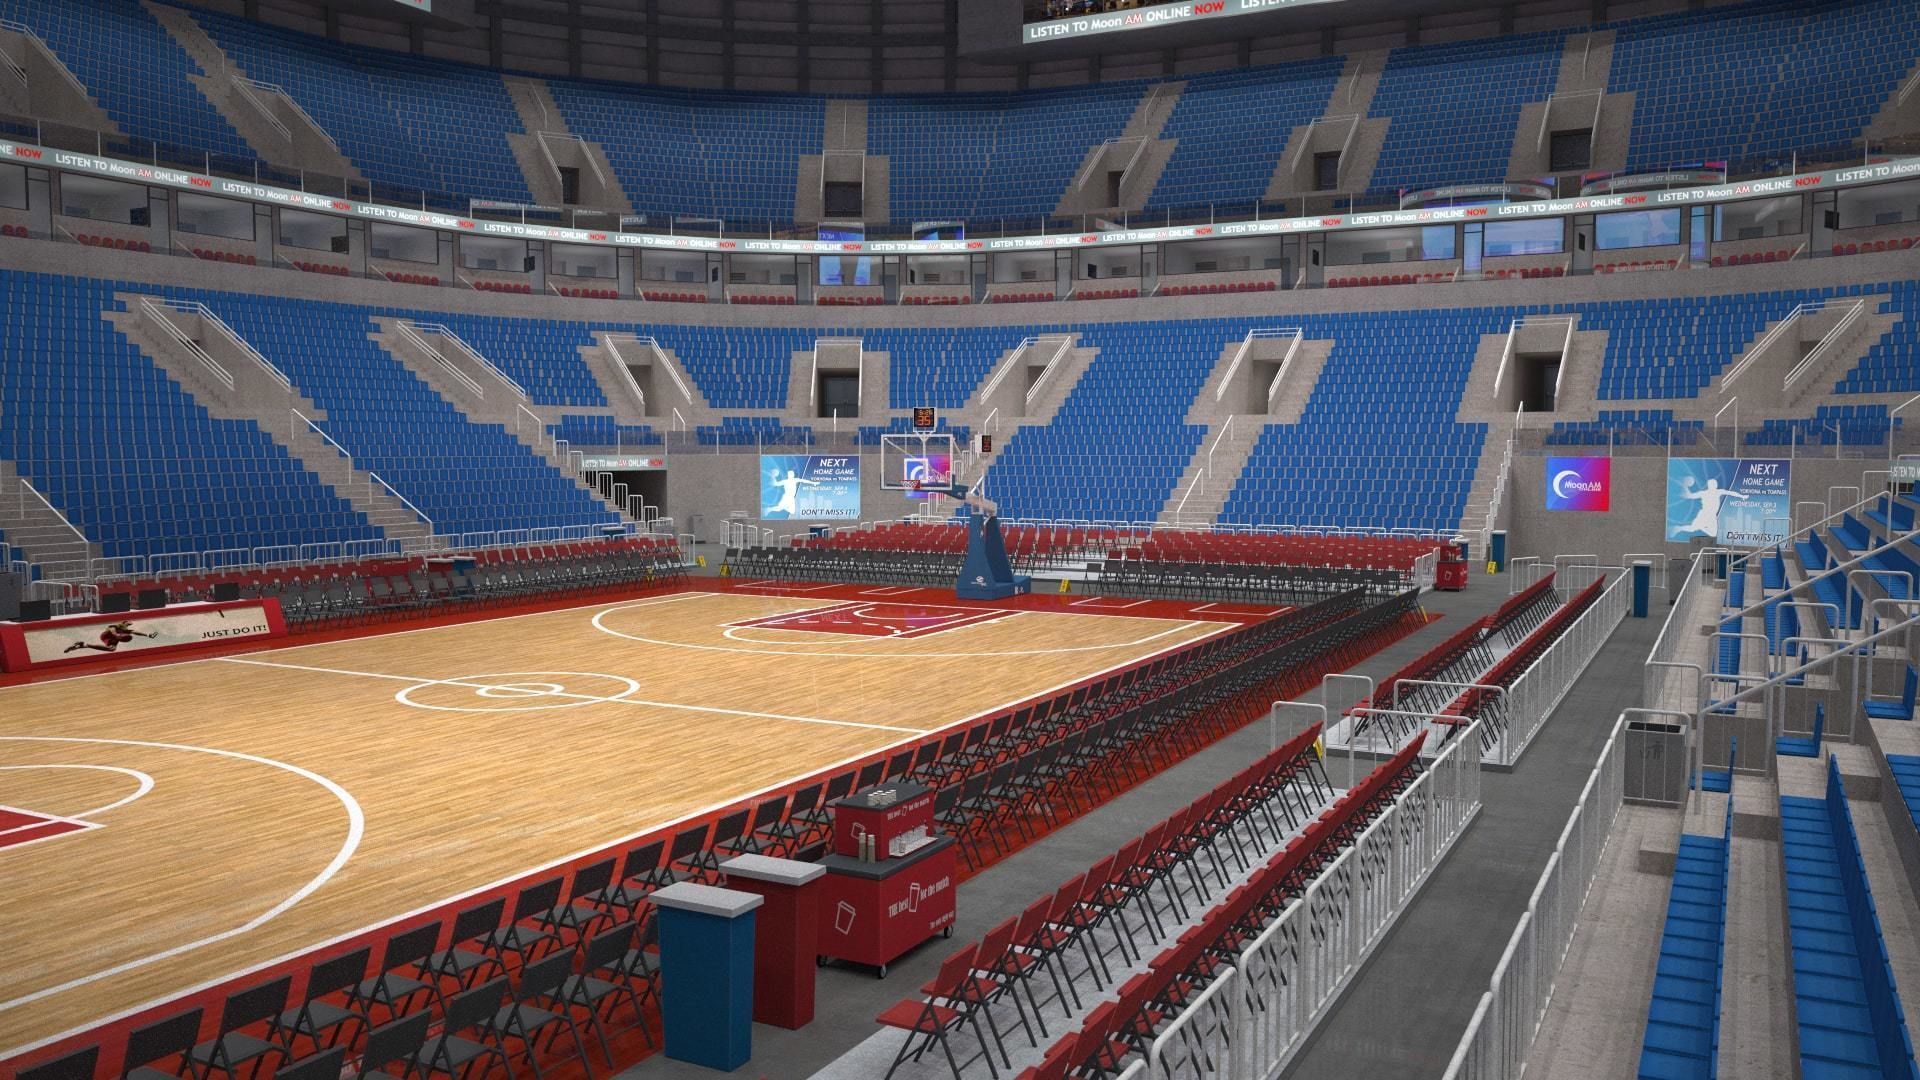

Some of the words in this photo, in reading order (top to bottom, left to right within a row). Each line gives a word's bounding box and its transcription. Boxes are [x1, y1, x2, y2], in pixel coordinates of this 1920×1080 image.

[1031, 24, 1068, 38] LISTEN
[1072, 22, 1088, 32] TO
[1091, 18, 1122, 30] Moon
[1125, 14, 1143, 25] AM
[1146, 7, 1191, 22] ONLINE
[1194, 1, 1225, 15] NOW
[16, 146, 42, 160] NOW
[56, 153, 90, 168] LISTEN
[93, 160, 107, 171] TO
[110, 163, 136, 176] Moon
[138, 168, 152, 178] AM
[154, 172, 188, 184] ONLINE
[190, 176, 212, 187] NOW
[1836, 169, 1872, 182] LISTEN
[1875, 166, 1889, 176] TO
[223, 182, 251, 195] LISTEN
[254, 188, 265, 197] TO
[266, 191, 289, 201] Moon
[303, 196, 332, 208] ONLINE
[332, 201, 352, 211] NOW
[1657, 191, 1689, 202] LISTEN
[1691, 190, 1704, 199] TO
[1706, 189, 1732, 198] Moon
[1735, 186, 1750, 195] AM
[1753, 180, 1792, 192] ONLINE
[1794, 176, 1822, 187] NOW
[1499, 204, 1529, 215] LISTEN
[1531, 203, 1545, 212] TO
[1549, 202, 1574, 211] Moon
[1590, 197, 1622, 208] ONLINE
[1624, 196, 1648, 204] NOW
[358, 205, 385, 217] LISTEN
[398, 211, 418, 221] Moon
[419, 215, 430, 223] AM
[432, 216, 458, 227] ONLINE
[458, 220, 476, 229] NOW
[1351, 215, 1380, 224] LISTEN
[1394, 213, 1416, 221] Moon
[1418, 212, 1430, 220] AM
[1433, 209, 1464, 219] ONLINE
[1466, 207, 1488, 216] NOW
[484, 224, 511, 233] LISTEN
[513, 226, 524, 234] TO
[526, 228, 546, 236] Moon
[561, 230, 588, 240] ONLINE
[1221, 225, 1246, 234] LISTEN
[1259, 223, 1279, 231] Moon
[1280, 221, 1291, 229] AM
[1293, 220, 1320, 228] ONLINE
[1322, 218, 1341, 226] NOW
[991, 240, 1013, 248] LISTEN
[1015, 239, 1024, 247] TO
[1025, 238, 1043, 246] Moon
[1055, 236, 1080, 245] ONLINE
[1081, 235, 1097, 243] NOW
[1102, 233, 1125, 241] LISTEN
[1126, 232, 1136, 240] TO
[1168, 228, 1194, 237] ONLINE
[1195, 227, 1212, 235] NOW
[615, 235, 641, 244] LISTEN
[643, 236, 654, 244] TO
[677, 239, 688, 247] AM
[689, 240, 717, 248] ONLINE
[719, 241, 736, 249] NOW
[770, 242, 780, 250] TO
[813, 243, 842, 251] ONLINE
[871, 243, 895, 251] LISTEN
[896, 243, 906, 251] TO
[940, 242, 966, 250] ONLINE
[820, 459, 848, 467] NEXT
[1749, 464, 1779, 475] NEXT
[1742, 478, 1763, 486] HOME
[1764, 478, 1785, 486] GAME
[202, 629, 229, 639] JUST
[232, 626, 250, 635] DO
[253, 624, 267, 632] IT!
